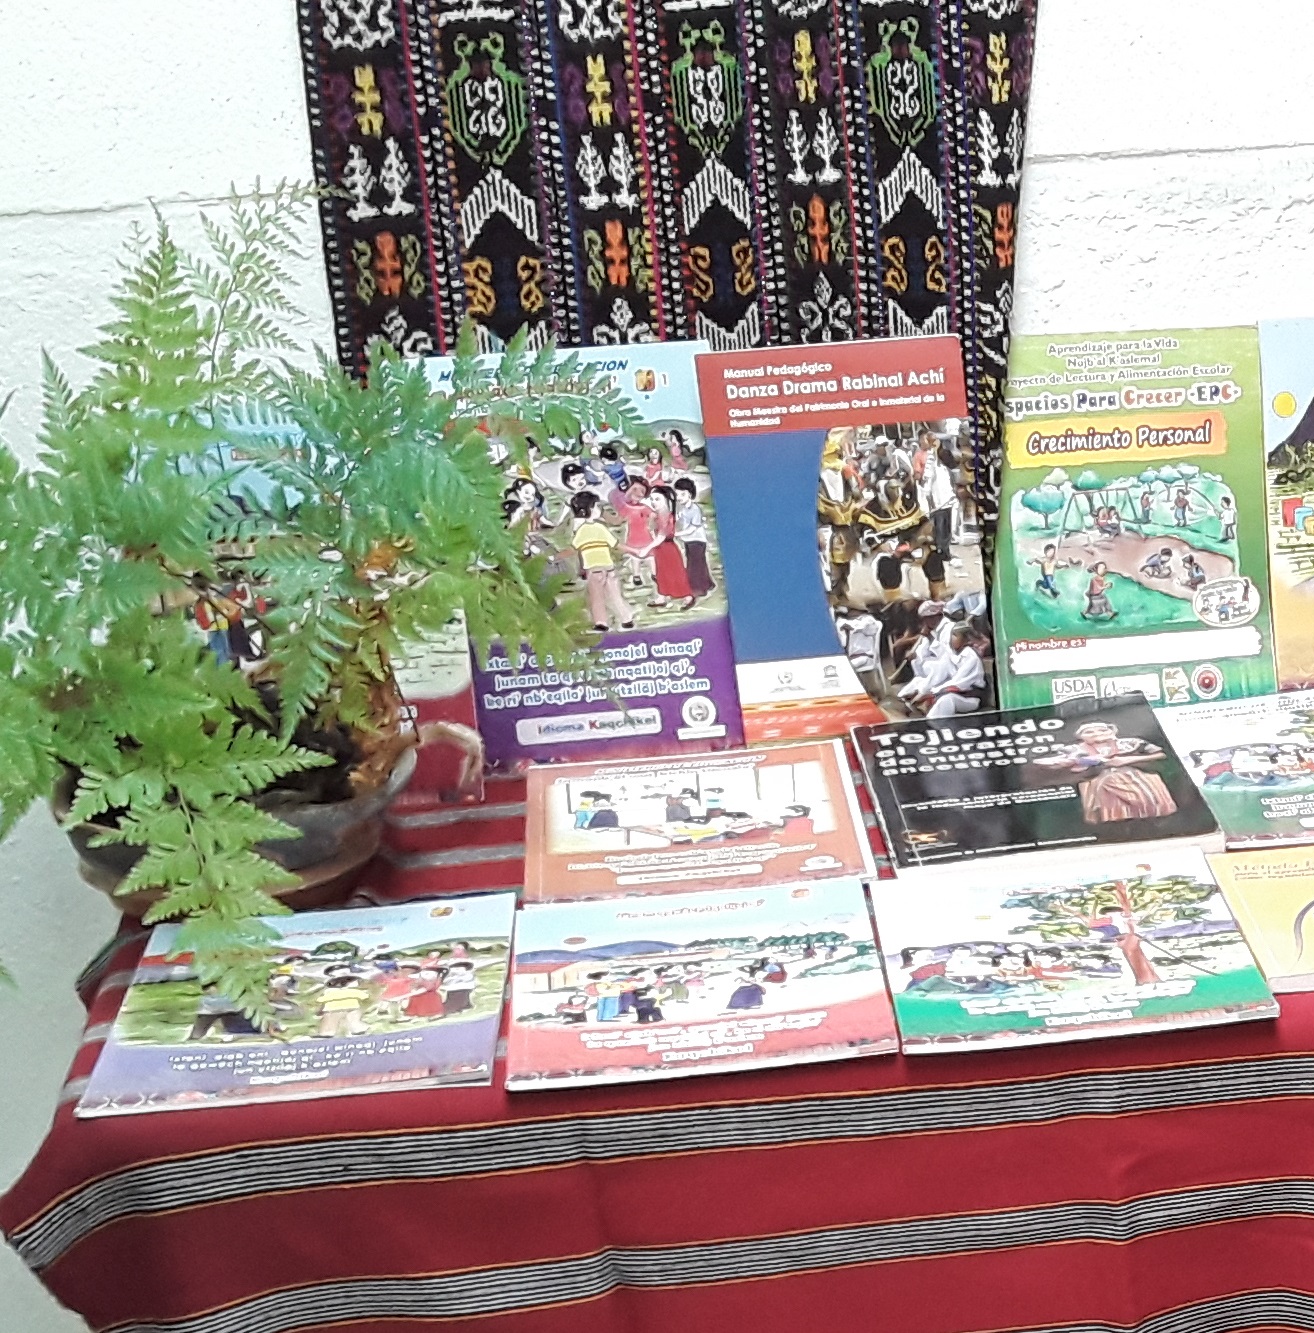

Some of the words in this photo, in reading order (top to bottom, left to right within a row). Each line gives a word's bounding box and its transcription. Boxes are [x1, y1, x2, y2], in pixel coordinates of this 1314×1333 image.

[1048, 341, 1113, 355] Aprendizaje
[1115, 341, 1140, 351] para
[1142, 339, 1153, 349] la
[1153, 337, 1178, 348] Vida
[723, 365, 765, 379] Manual
[766, 361, 833, 376] Pedagógico
[1049, 374, 1062, 384] de
[1065, 373, 1107, 384] Lectura
[1109, 373, 1116, 382] y
[1118, 366, 1189, 380] Alimentación
[1192, 365, 1232, 376] Escolar
[726, 381, 779, 400] Danza
[782, 378, 838, 396] Drama
[842, 371, 902, 391] Rabinal
[907, 366, 945, 387] Achí
[728, 408, 751, 418] Obra
[789, 403, 804, 414] del
[851, 398, 870, 409] Oral
[922, 394, 935, 404] de
[936, 392, 945, 402] la
[1006, 394, 1070, 418] spacios
[1076, 391, 1117, 407] Para
[1123, 388, 1183, 405] Crecer
[1027, 427, 1132, 456] Crecimiento
[1136, 418, 1213, 447] Personal
[1028, 638, 1068, 650] nombre
[1053, 678, 1095, 694] USDA
[537, 722, 585, 737] Idioma
[869, 719, 1065, 747] Tejiendo
[875, 745, 907, 759] el
[918, 734, 1055, 755] corazón
[879, 757, 918, 768] de
[928, 743, 1065, 764] nuestros
[882, 757, 1028, 777] ancestros
